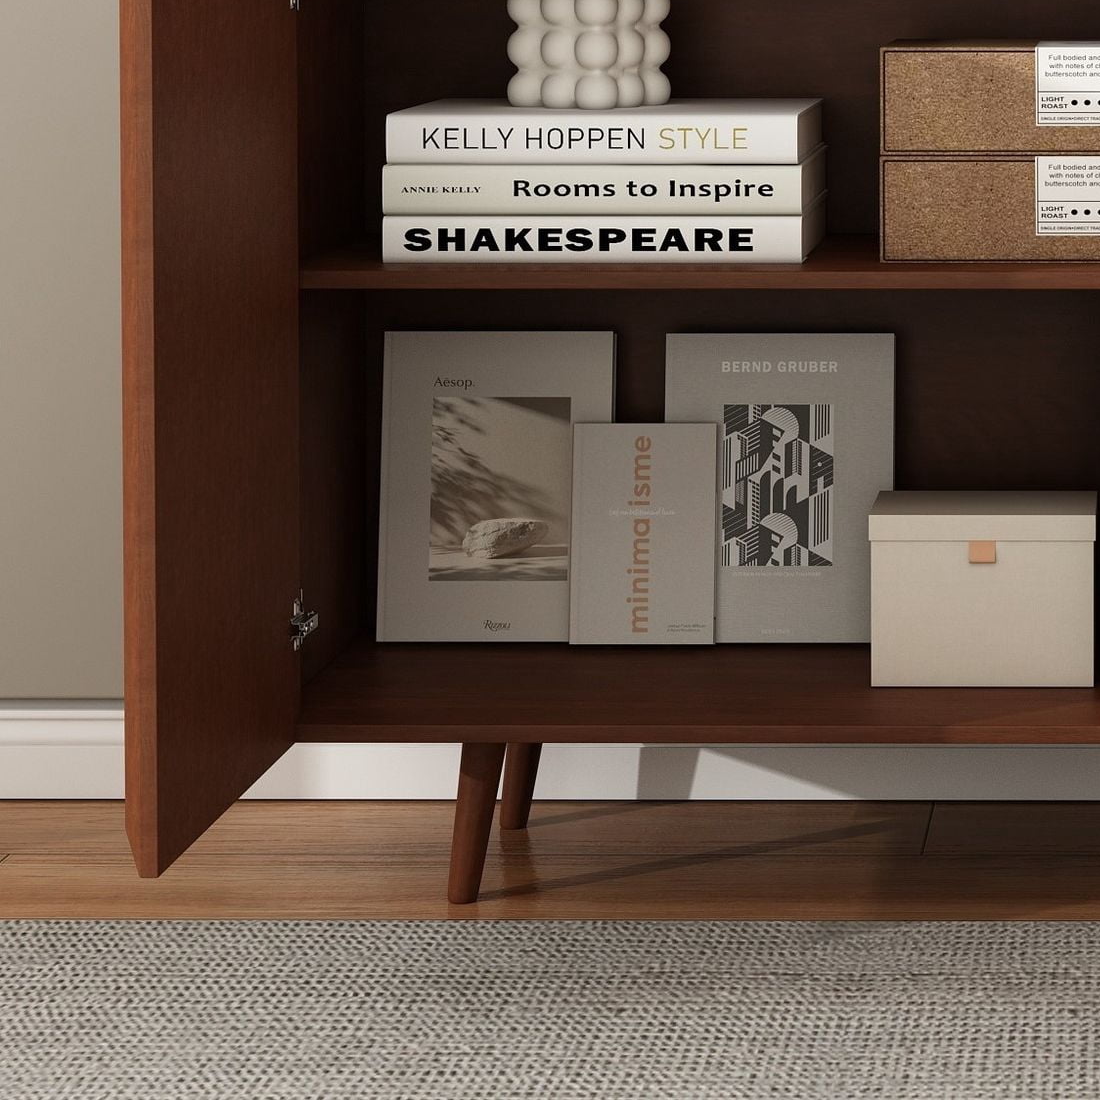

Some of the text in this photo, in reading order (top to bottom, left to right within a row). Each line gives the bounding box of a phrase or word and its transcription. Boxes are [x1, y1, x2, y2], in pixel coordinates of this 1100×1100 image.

[422, 127, 749, 150] KELLY HOPPEN STYLE
[400, 179, 775, 203] ANNIE KELLY Rooms to Inspire
[403, 227, 754, 252] SHAKESPEARE
[721, 361, 838, 373] BERND GRUBER
